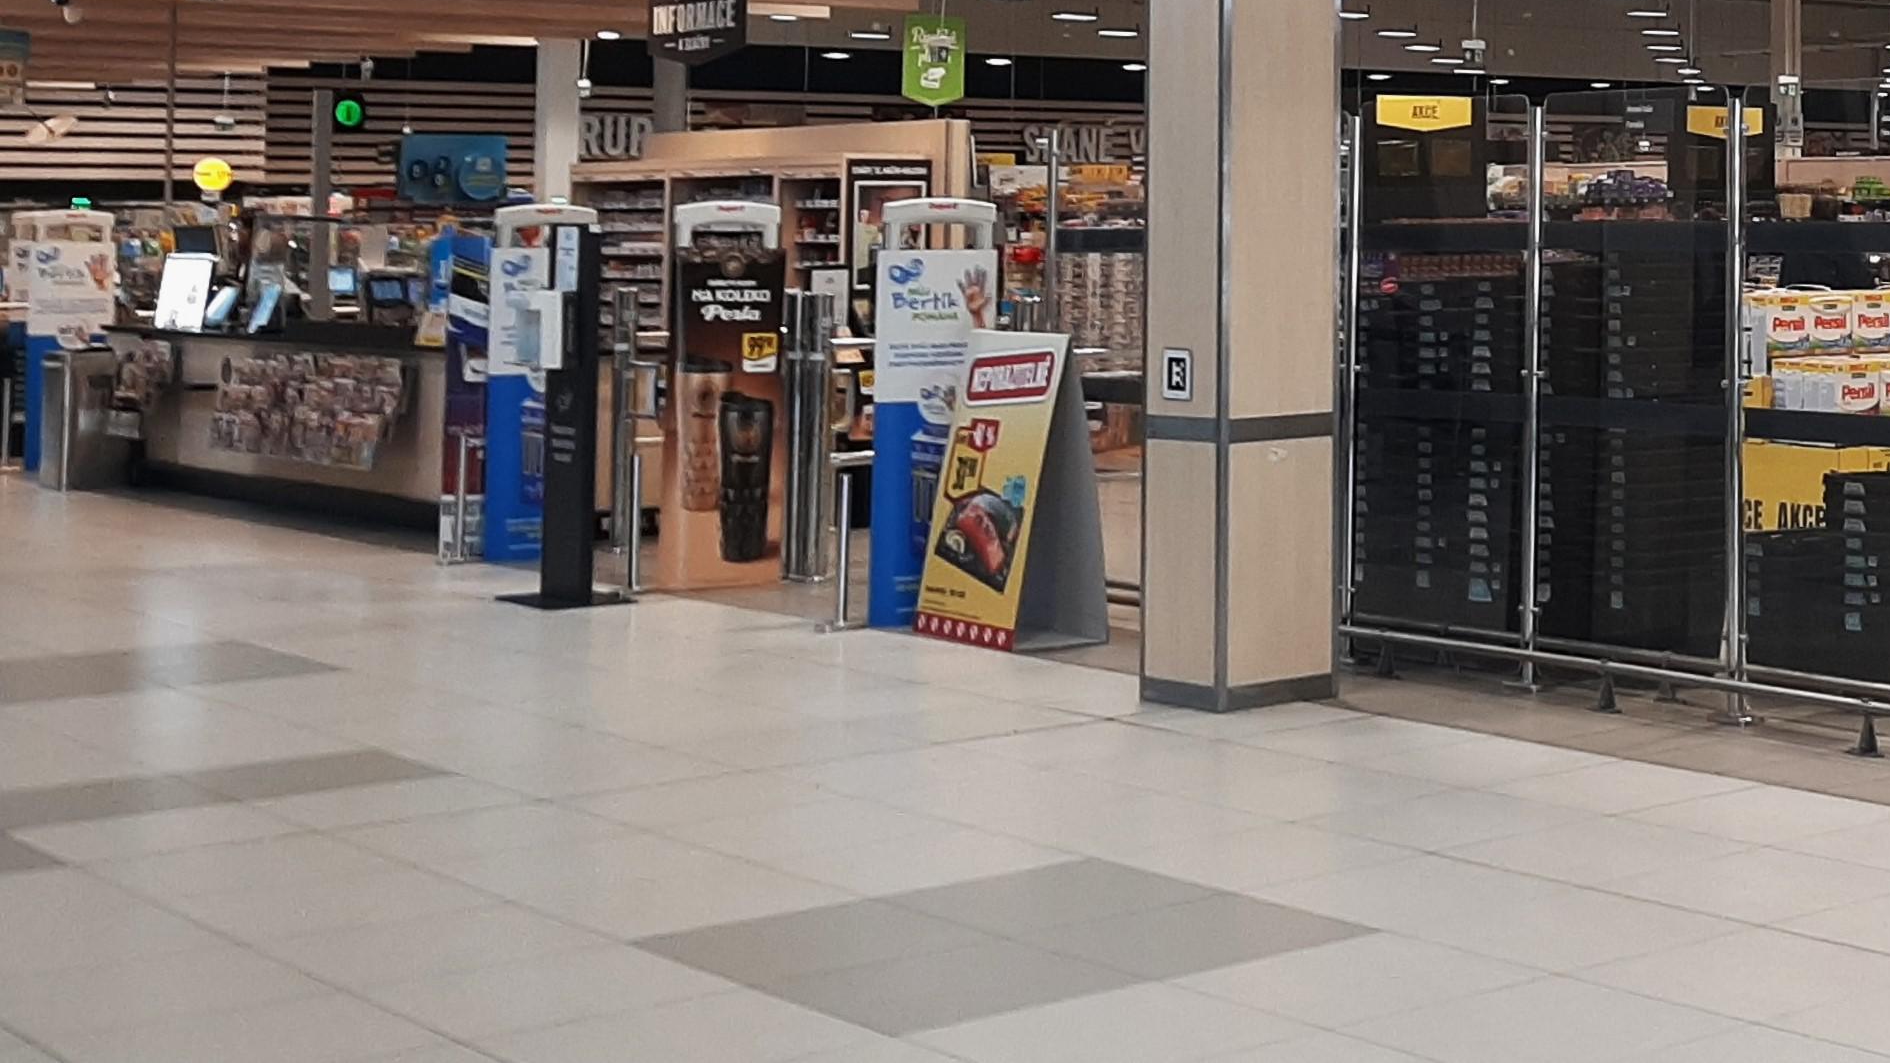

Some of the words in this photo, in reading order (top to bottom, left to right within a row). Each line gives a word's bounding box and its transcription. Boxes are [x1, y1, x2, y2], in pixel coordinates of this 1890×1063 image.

[1411, 104, 1440, 119] AKCE
[1772, 317, 1805, 333] Persil
[1814, 313, 1848, 330] Persil
[1857, 312, 1890, 329] Persil
[1842, 384, 1876, 401] Persil
